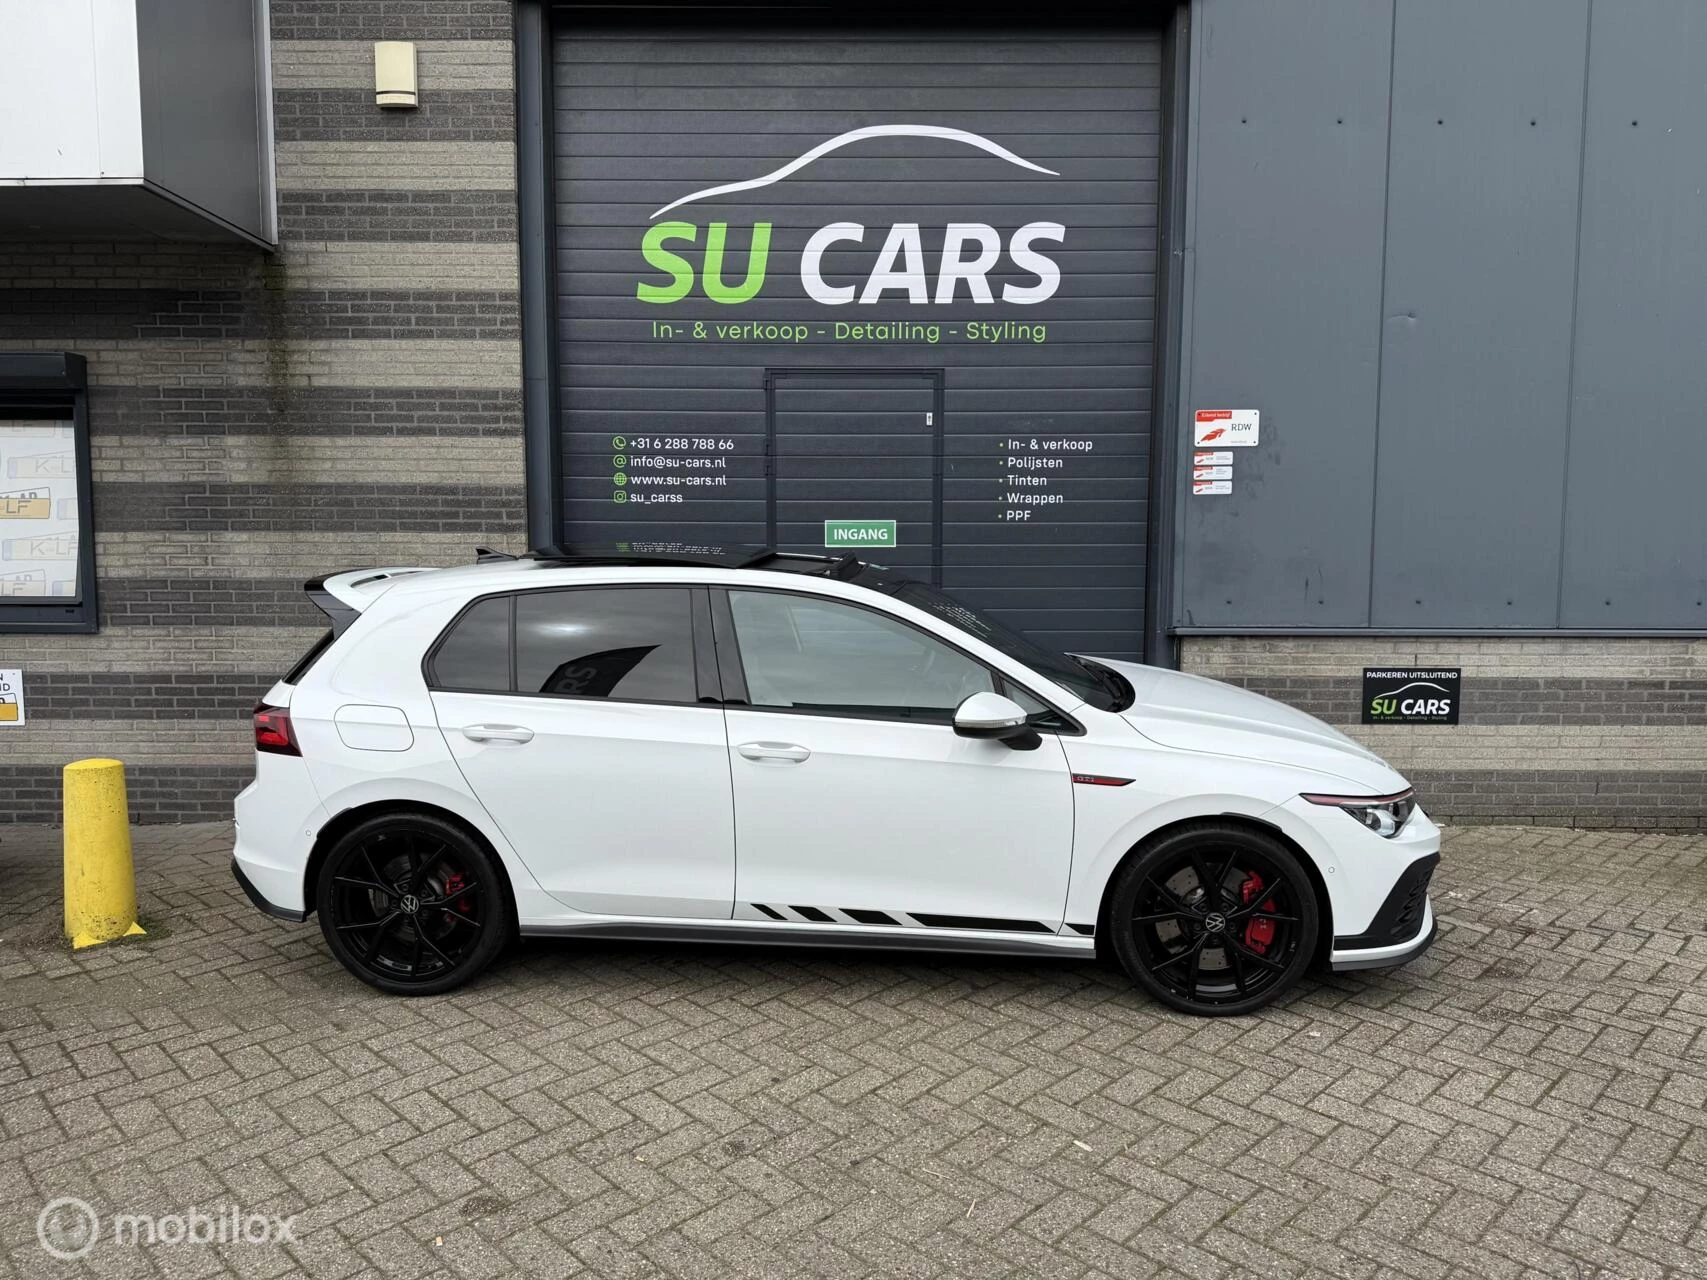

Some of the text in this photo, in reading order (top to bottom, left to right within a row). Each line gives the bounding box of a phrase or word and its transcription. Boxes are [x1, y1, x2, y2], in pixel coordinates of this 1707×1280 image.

[637, 221, 1066, 305] SU CARS
[652, 321, 683, 339] In-
[693, 322, 707, 339] &
[717, 321, 808, 343] verkoop
[835, 321, 940, 343] Detailing
[966, 321, 1047, 343] Styling
[1231, 423, 1252, 431] RDW
[630, 438, 735, 450] +31 6 288 788 66
[1008, 438, 1093, 452] In- & verkoop
[630, 455, 727, 469] info@su-cars.nl
[1007, 456, 1063, 470] Polijsten
[630, 474, 727, 486] www.su-cars.nl
[1007, 474, 1047, 486] Tinten
[630, 493, 683, 505] su_carss
[1006, 492, 1063, 506] Wrappen
[1006, 510, 1031, 521] PPF
[833, 528, 888, 540] INGANG
[1366, 671, 1458, 679] PARKEREN UITSLUITEND
[1370, 699, 1451, 715] SU CARS
